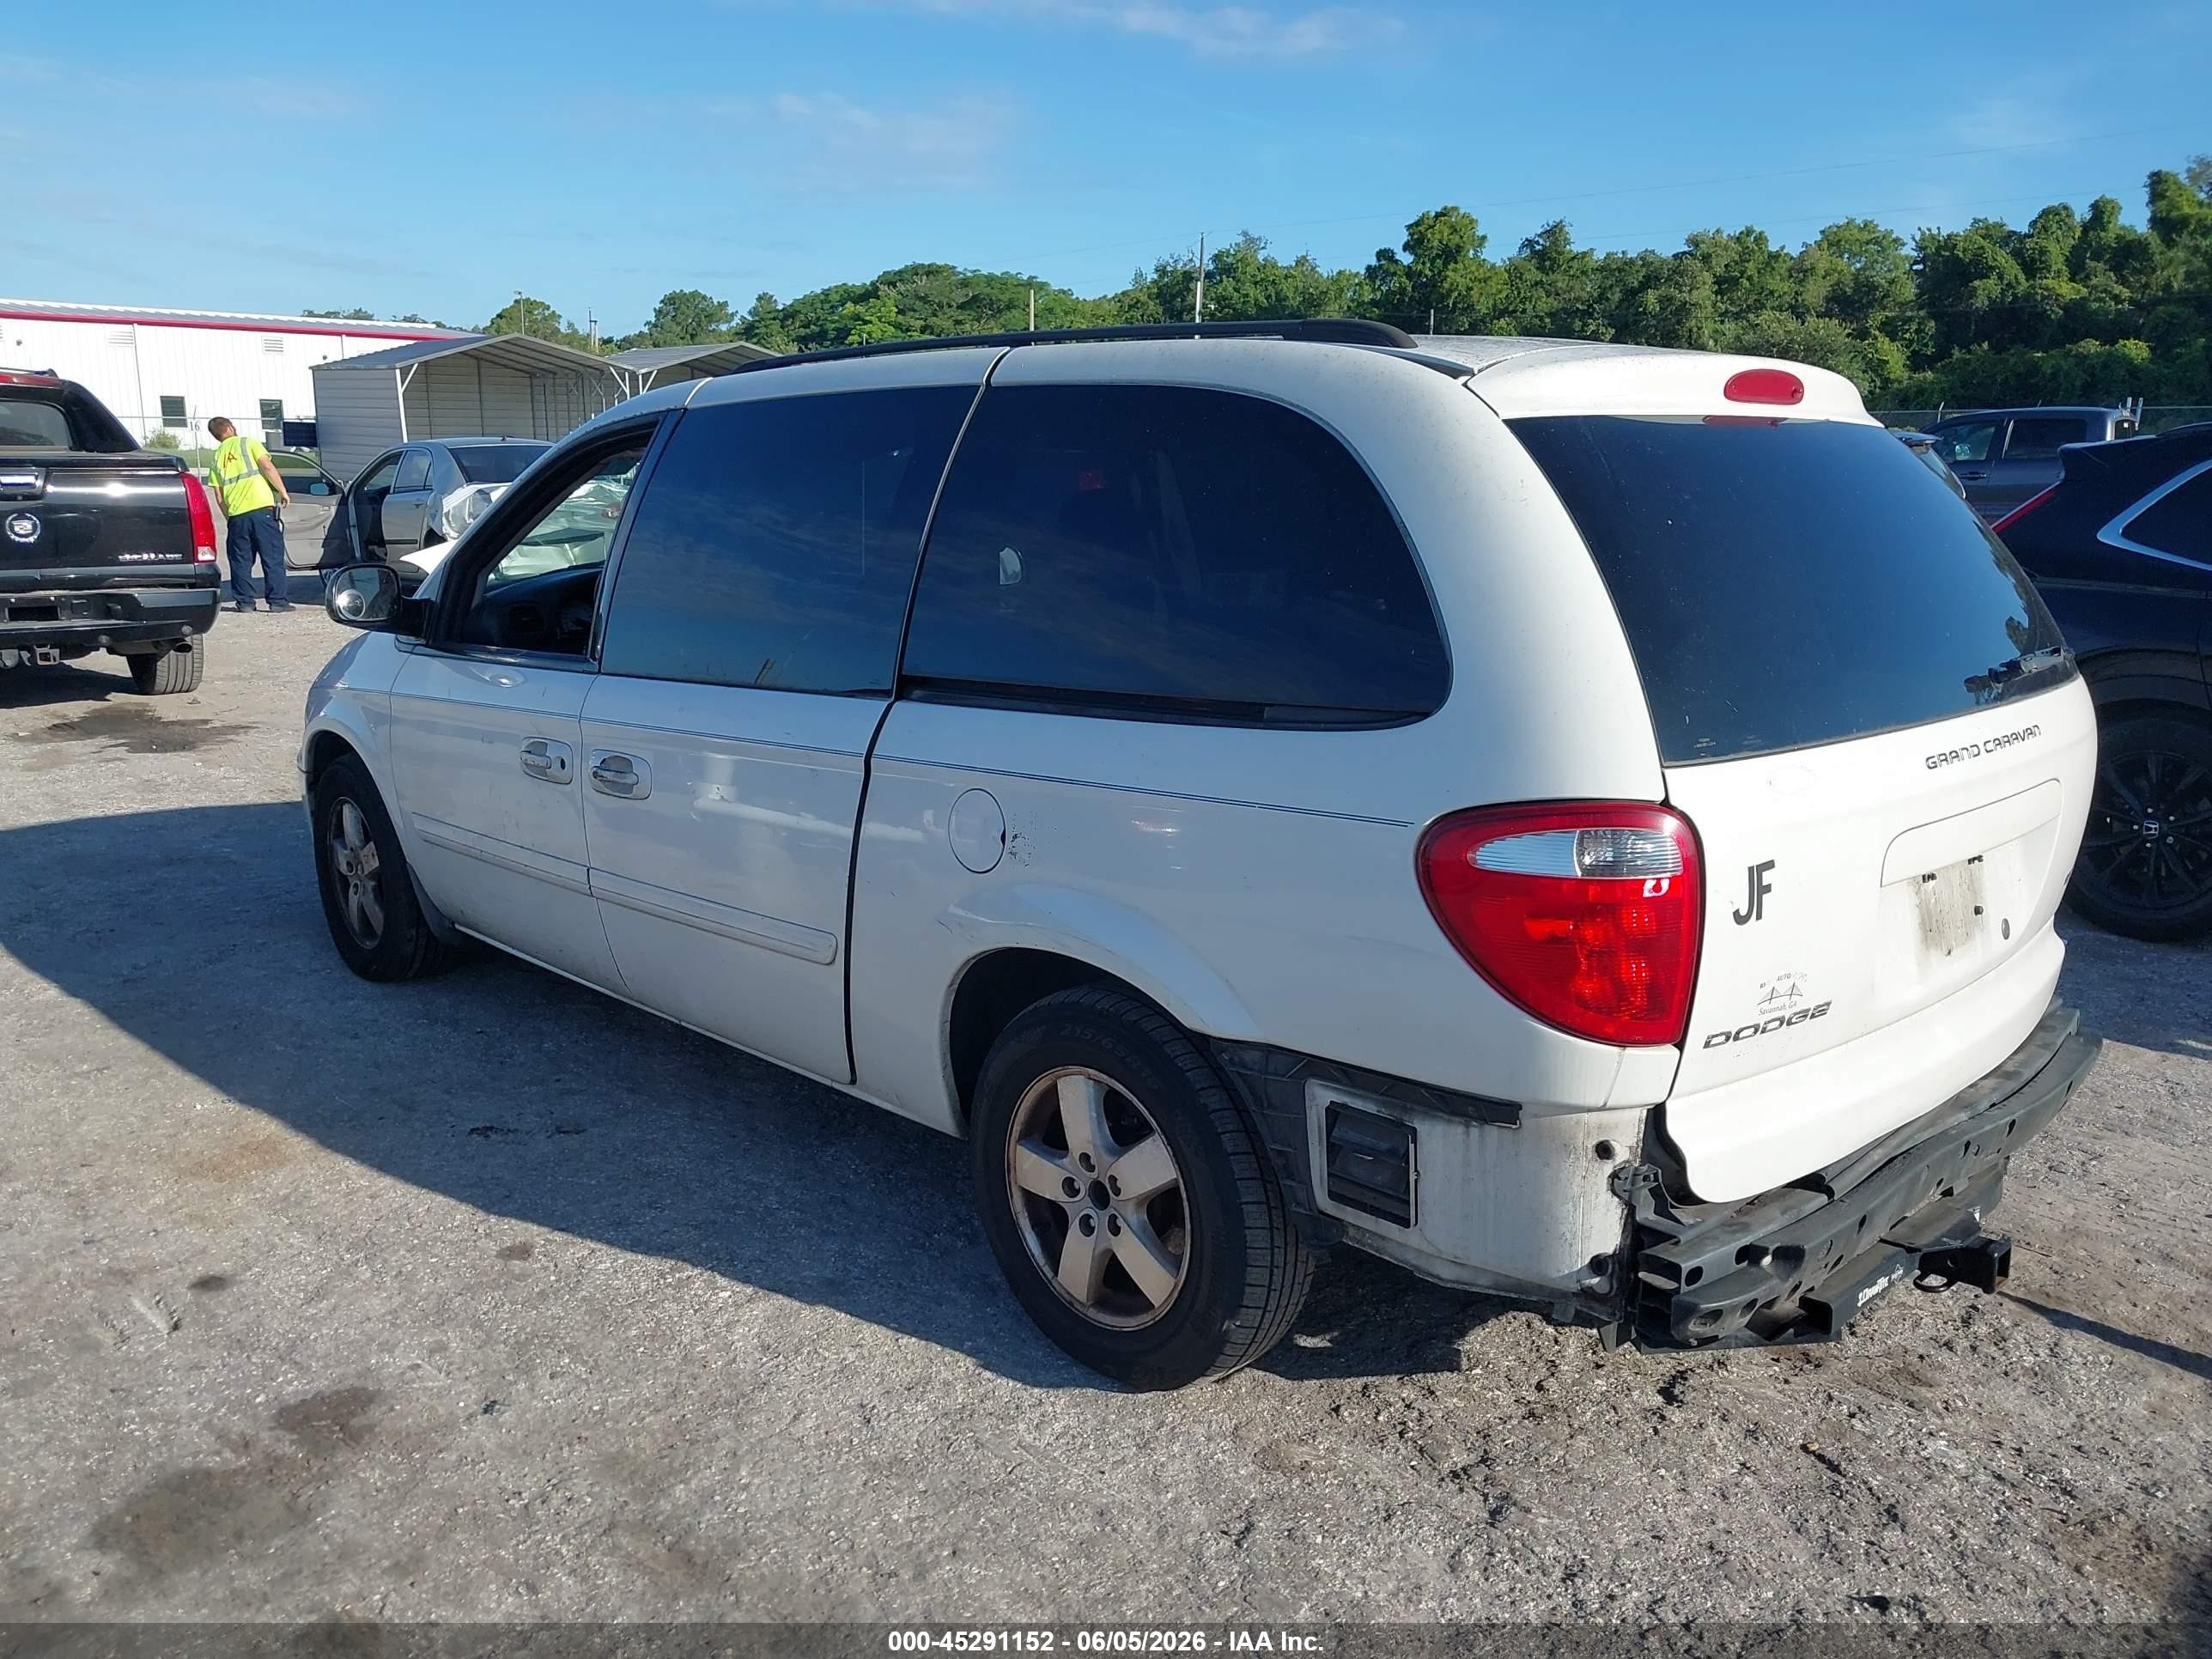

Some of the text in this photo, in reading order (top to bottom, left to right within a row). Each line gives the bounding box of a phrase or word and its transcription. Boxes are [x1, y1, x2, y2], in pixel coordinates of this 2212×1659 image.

[189, 420, 200, 432] 16
[1925, 724, 2042, 770] GRAND CARAVAN
[1732, 859, 1776, 927] JF
[1702, 1000, 1832, 1050] DODGE
